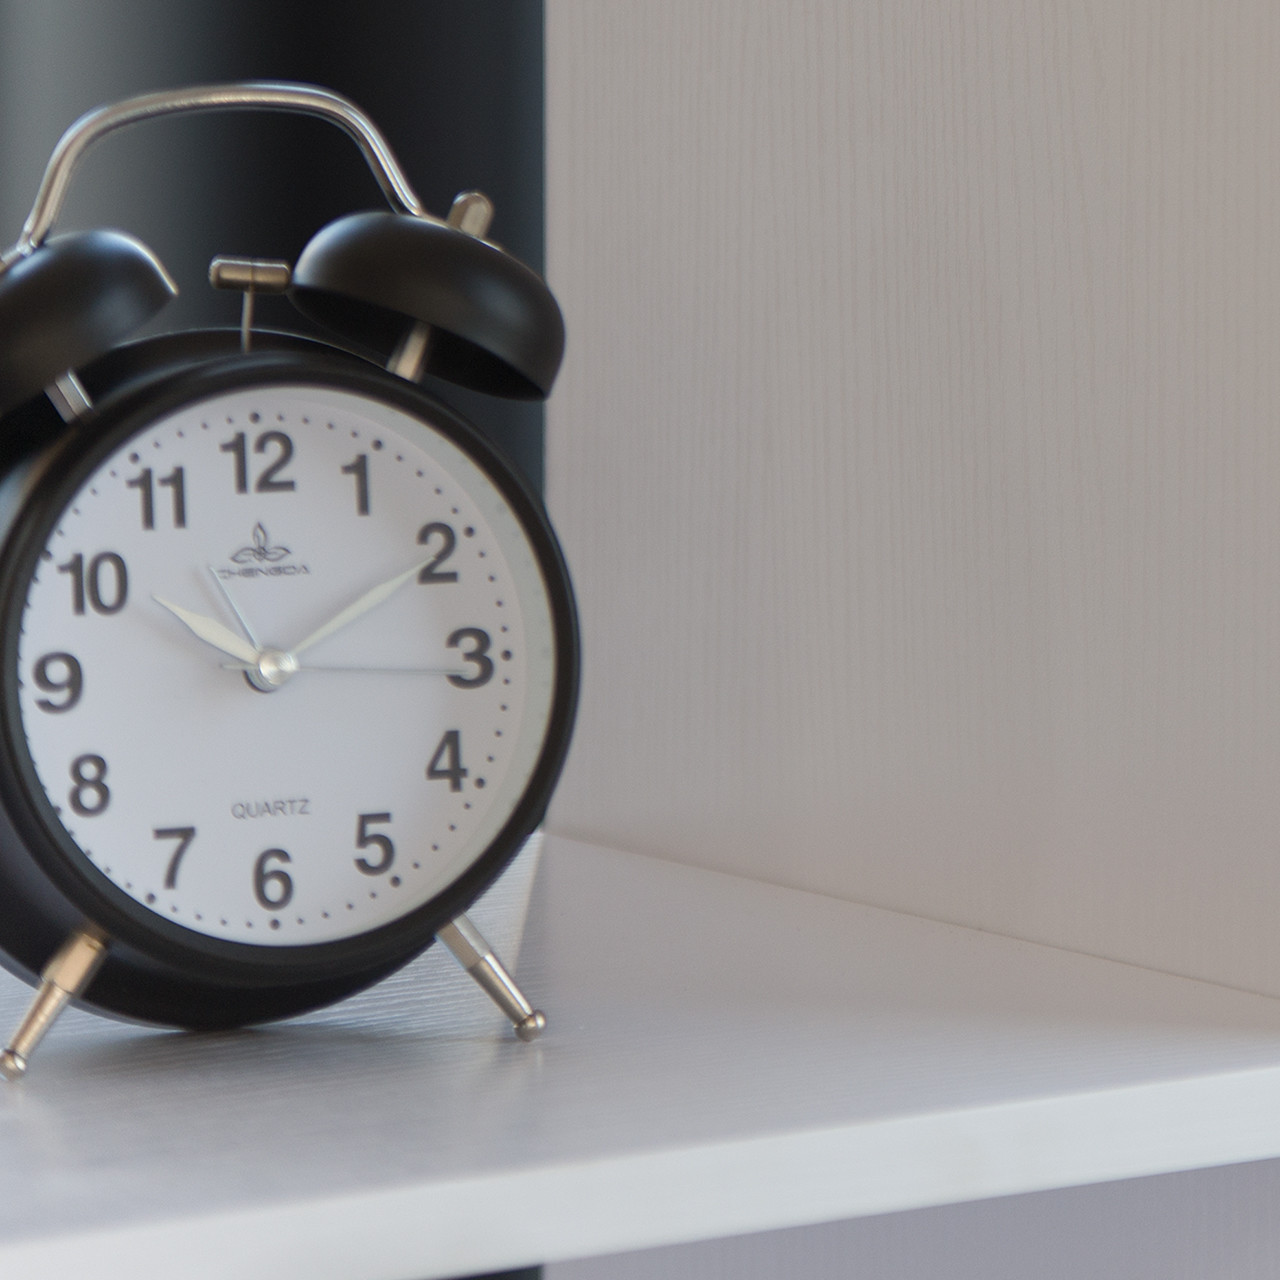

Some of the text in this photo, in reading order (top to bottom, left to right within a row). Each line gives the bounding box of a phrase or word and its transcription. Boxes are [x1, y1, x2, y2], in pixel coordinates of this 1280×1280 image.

[219, 430, 296, 494] 12
[341, 454, 370, 516] 1
[126, 465, 187, 530] 11
[57, 551, 128, 615] 10
[416, 522, 458, 584] 2
[32, 651, 83, 714] 9
[445, 627, 494, 689] 3
[68, 753, 111, 817] 8
[425, 729, 468, 792] 4
[231, 798, 310, 820] QUARTZ
[152, 826, 196, 889] 7
[354, 812, 395, 876] 5
[252, 847, 294, 912] 6
